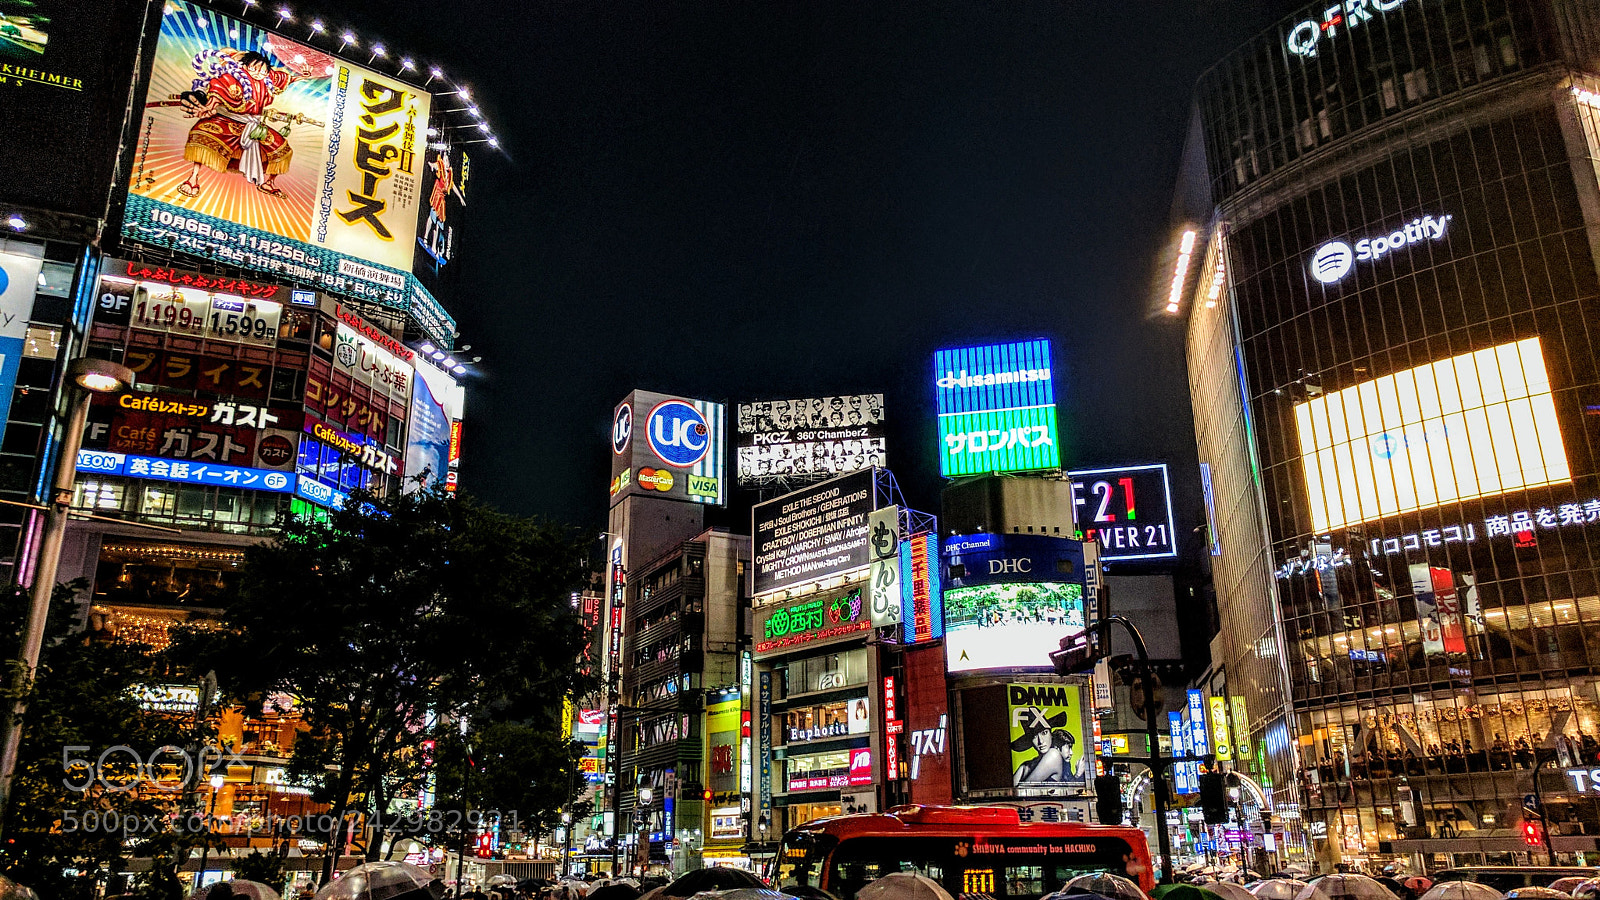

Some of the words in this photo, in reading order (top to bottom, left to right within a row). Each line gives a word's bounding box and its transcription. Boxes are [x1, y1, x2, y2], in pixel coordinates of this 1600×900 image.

[334, 78, 407, 242] ワンピース
[1355, 215, 1446, 260] Spotify
[126, 261, 280, 298] しゃぶしゃぶバイキング
[100, 292, 130, 311] 9F
[137, 301, 204, 330] 1,199円
[211, 311, 276, 340] 1,599円
[126, 351, 264, 389] プライス
[361, 350, 407, 393] しゃぶ葉
[210, 401, 279, 429] ガスト
[117, 425, 157, 441] Café
[159, 427, 247, 462] ガスト
[945, 425, 1053, 455] サロンパス
[360, 443, 398, 475] ガスト
[130, 457, 260, 485] 英会話イーオン
[267, 475, 285, 488] 6F
[301, 480, 328, 501] AEON
[691, 480, 718, 493] VISA
[782, 502, 800, 515] EXILE
[799, 496, 812, 508] THE
[812, 487, 840, 504] SECOND
[820, 489, 868, 512] GENERATIONS
[762, 533, 796, 552] CRAZYBOY
[799, 520, 838, 541] DOBERMAN
[774, 525, 792, 538] EXILE
[1145, 524, 1167, 546] 21
[789, 537, 822, 555] ANARCHY
[945, 543, 960, 552] DHC
[961, 539, 991, 550] Channel
[761, 558, 785, 574] MIGHTY
[774, 566, 801, 581] METHOD
[988, 557, 1032, 575] DHC
[790, 608, 824, 633] 西村
[1010, 685, 1068, 707] DMM
[1012, 707, 1051, 728] FX
[790, 722, 847, 742] Euphoria
[972, 844, 1005, 854] SHIBUYA
[1007, 844, 1048, 856] community
[1049, 844, 1064, 854] bus
[1064, 844, 1097, 854] HACHIKO
